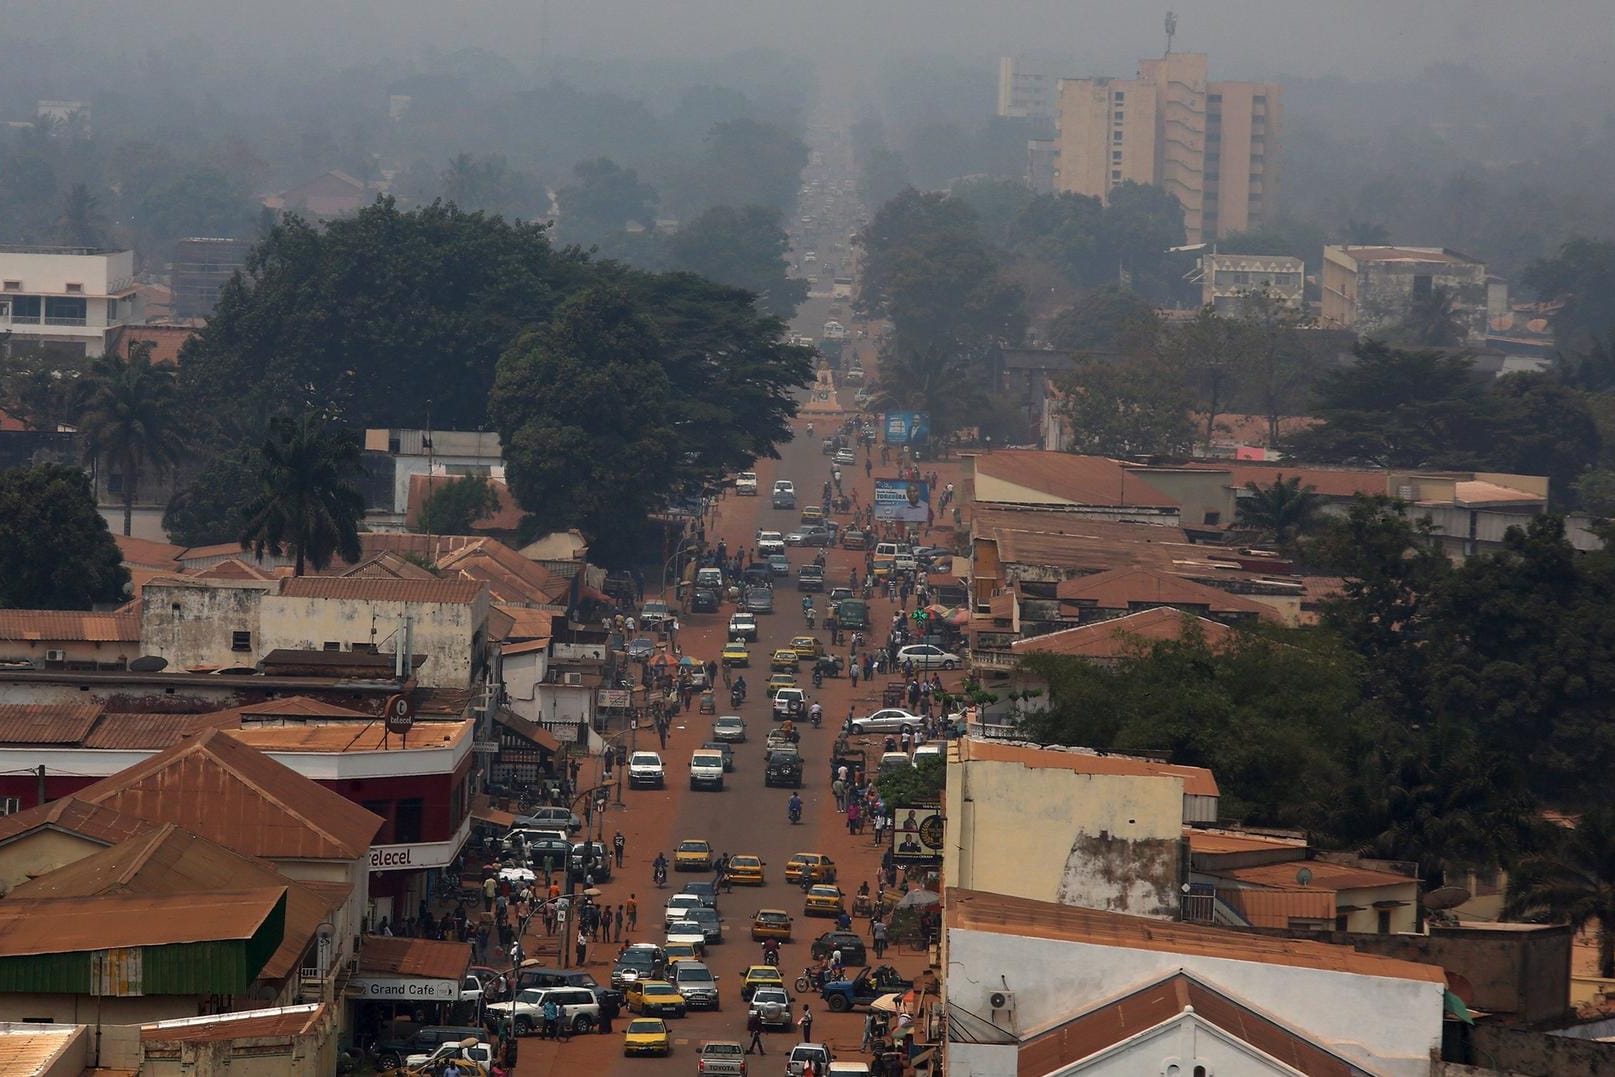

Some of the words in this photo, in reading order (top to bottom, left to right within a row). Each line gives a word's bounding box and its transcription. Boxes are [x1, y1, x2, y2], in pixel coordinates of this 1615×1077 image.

[390, 715, 412, 724] telecel
[369, 849, 411, 866] elecel
[370, 984, 405, 995] Grand
